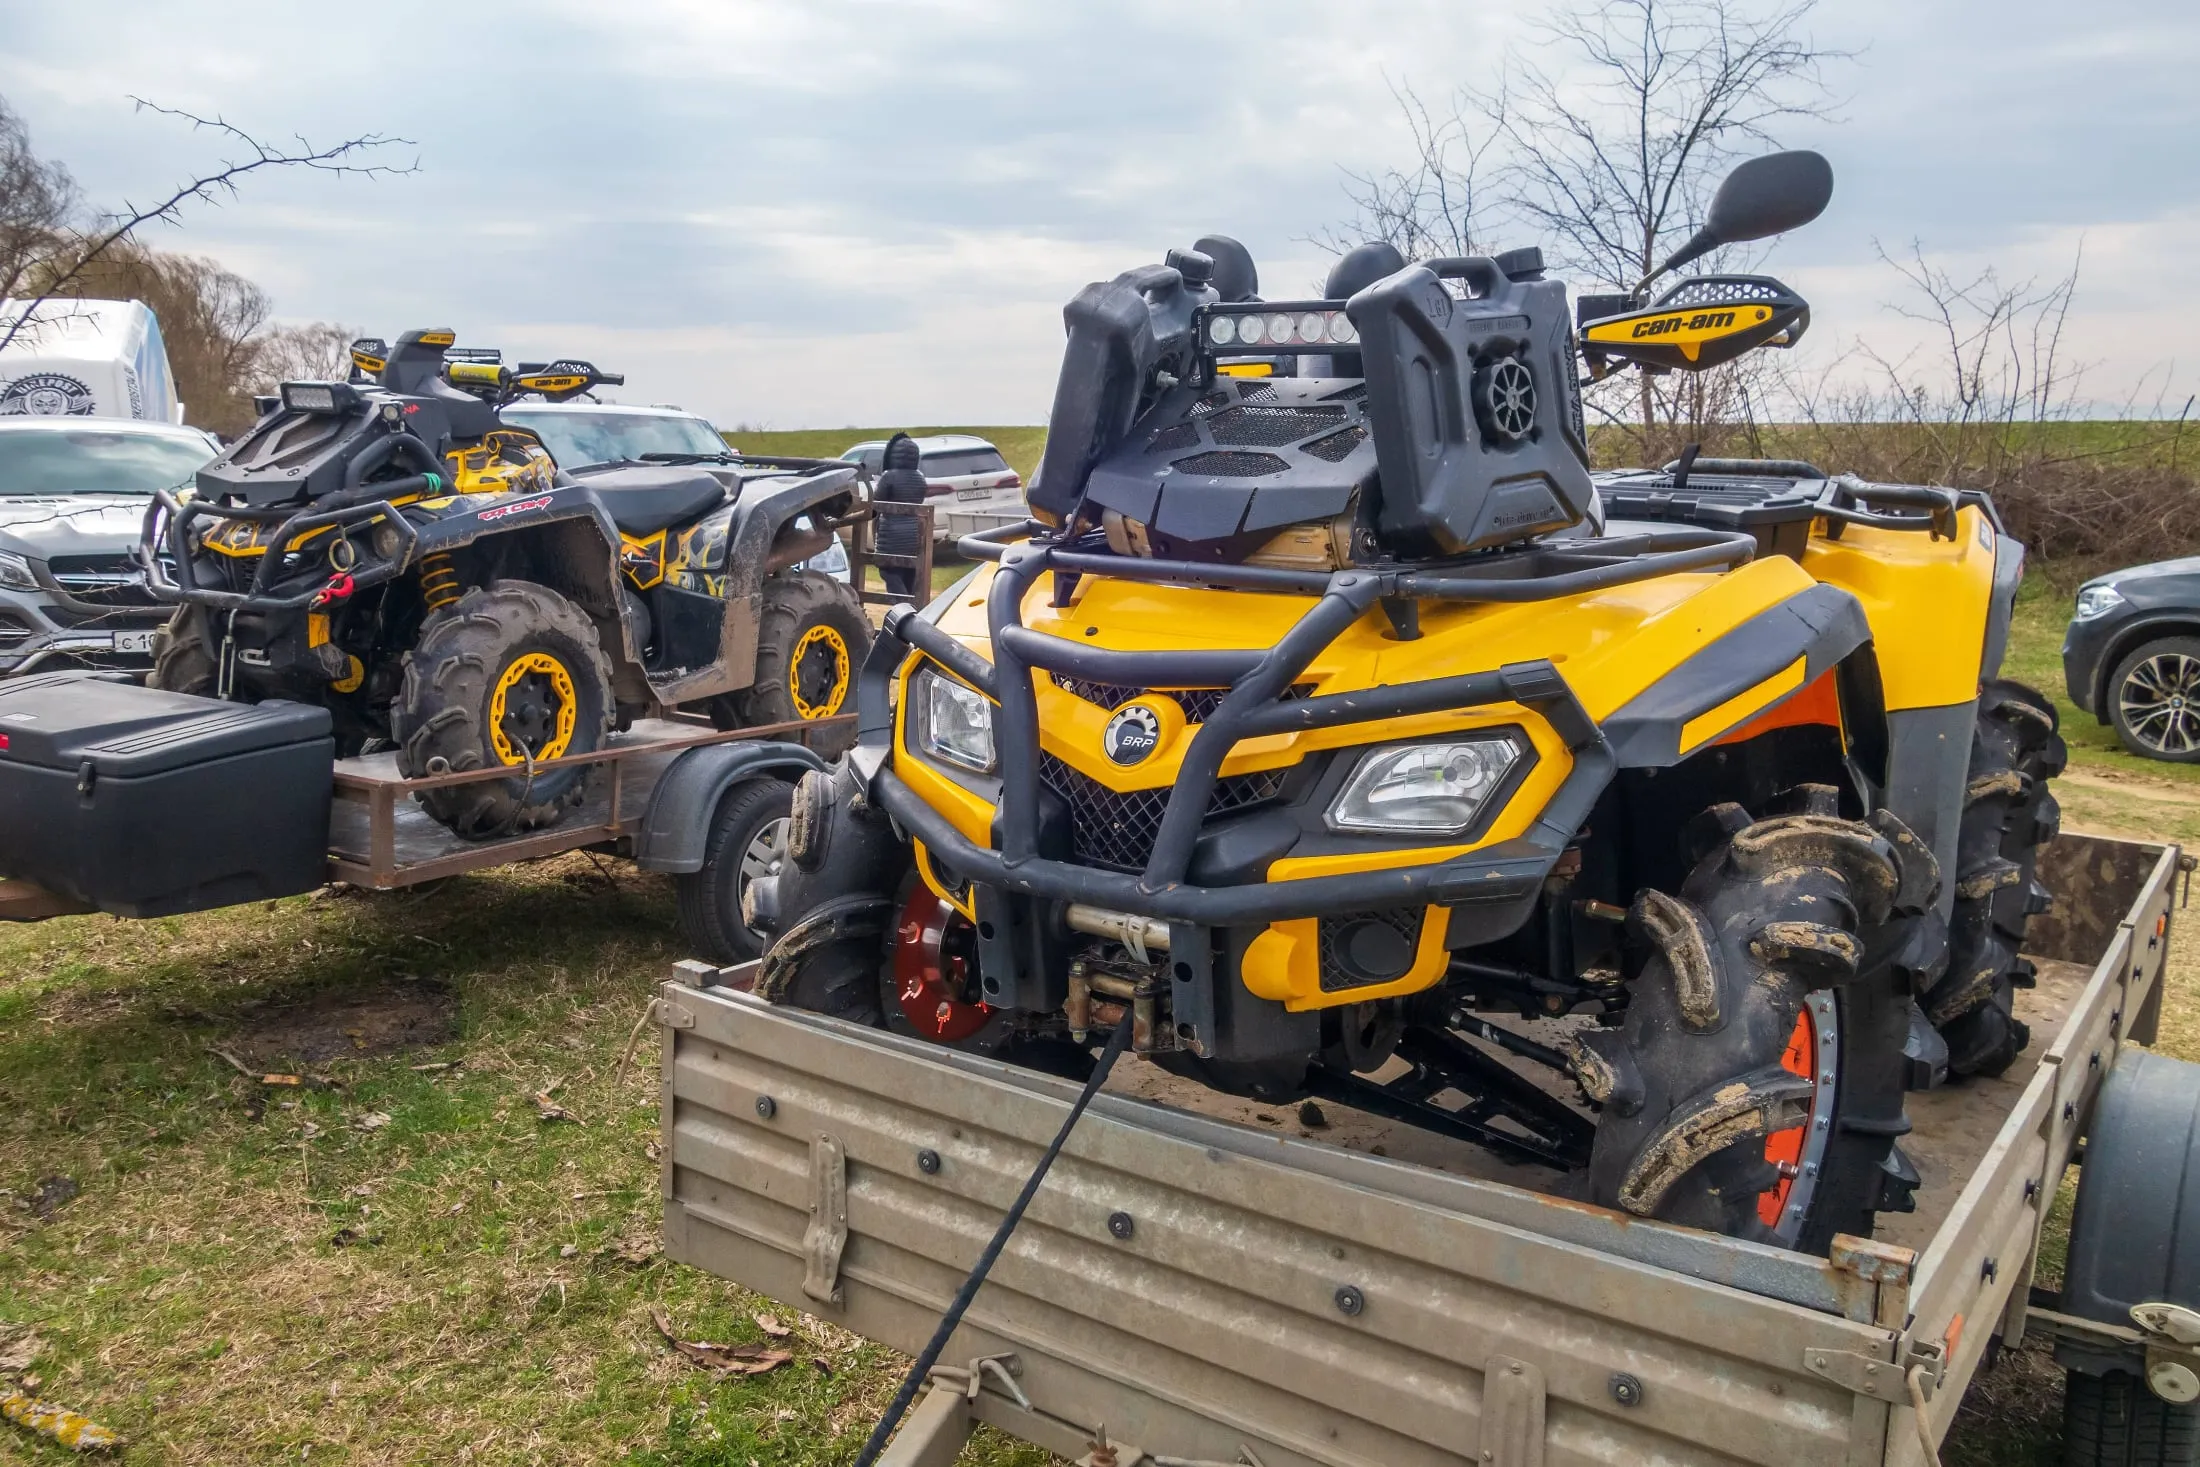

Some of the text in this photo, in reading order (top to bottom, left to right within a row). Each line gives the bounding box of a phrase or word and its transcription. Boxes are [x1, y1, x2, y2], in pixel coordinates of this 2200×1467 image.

[1632, 312, 1735, 338] can-am
[535, 378, 571, 387] can-am
[1122, 735, 1154, 748] BRP
